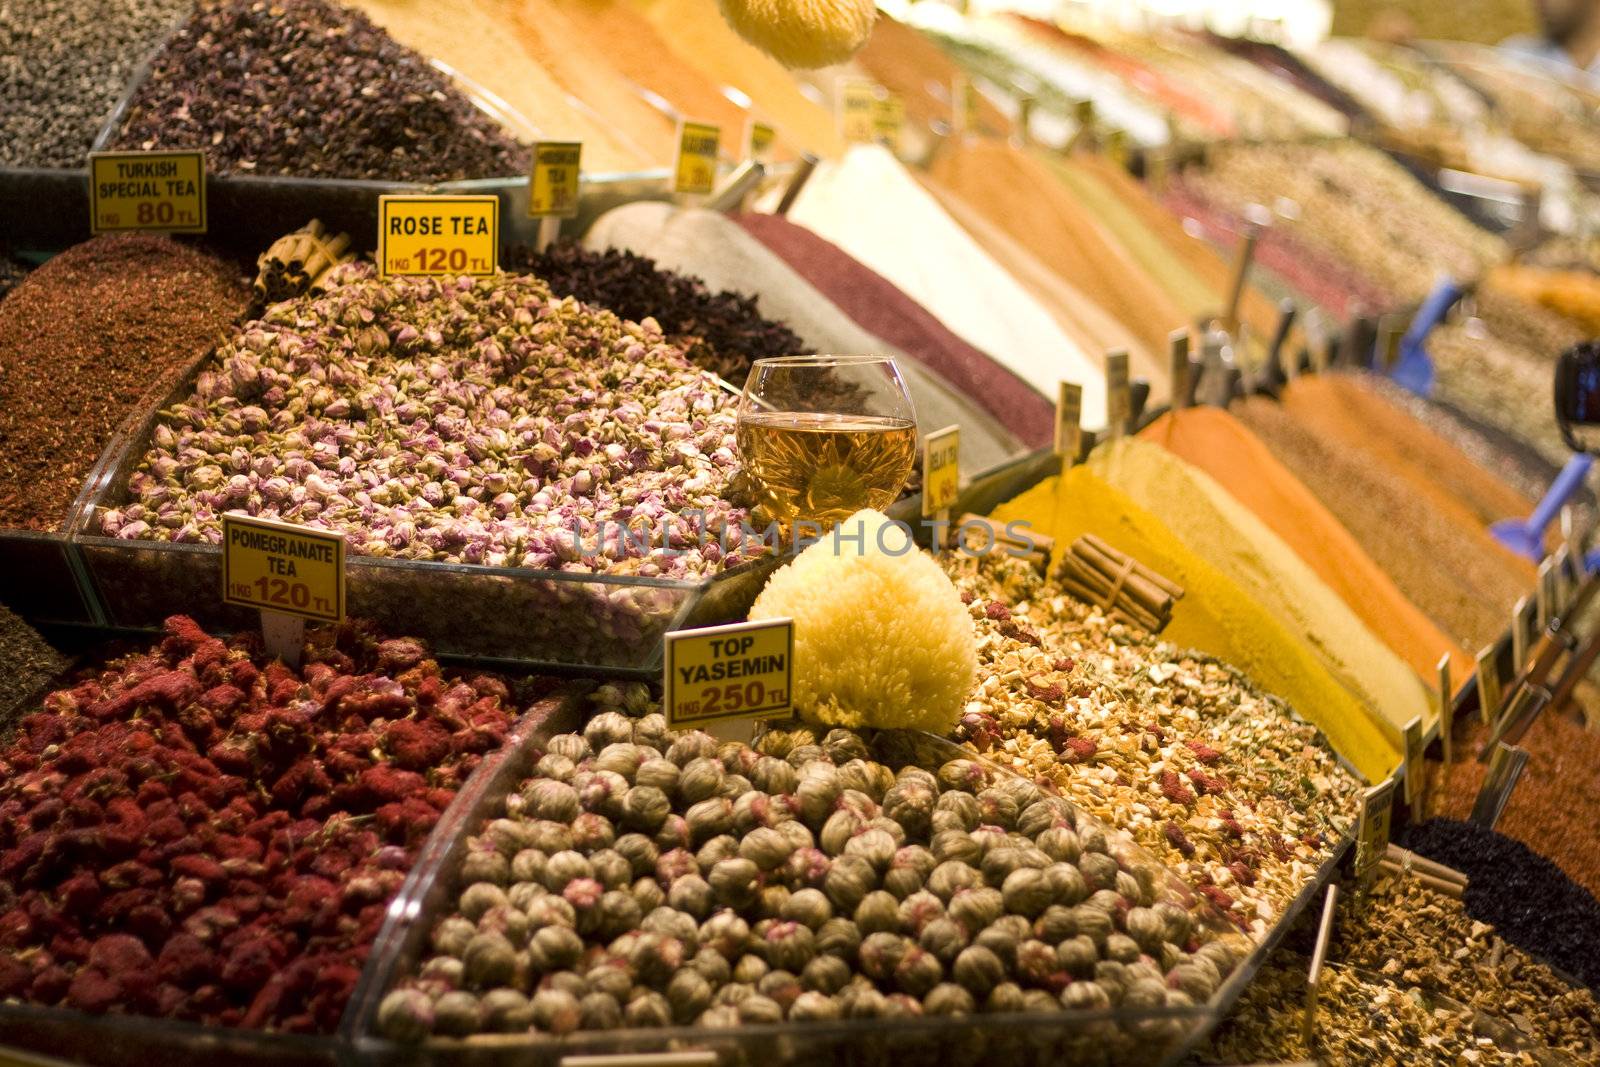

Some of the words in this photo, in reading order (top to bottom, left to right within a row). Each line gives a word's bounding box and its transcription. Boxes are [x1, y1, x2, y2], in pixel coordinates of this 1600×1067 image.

[117, 162, 177, 178] TURKISH
[100, 181, 161, 199] SPECIAL
[166, 180, 196, 196] TEA
[137, 202, 174, 225] 80
[177, 210, 197, 223] TL
[390, 216, 443, 235] ROSE
[450, 216, 489, 235] TEA
[389, 257, 410, 271] 1KG
[413, 247, 468, 271] 120
[470, 257, 490, 271] TL
[231, 528, 333, 563] POMEGRANATE
[267, 556, 297, 578] TEA
[254, 576, 311, 608] 120
[314, 598, 334, 612] TL
[709, 636, 754, 658] TOP
[679, 654, 785, 685] YASEMiN
[702, 681, 765, 712] 250
[768, 689, 786, 703] TL
